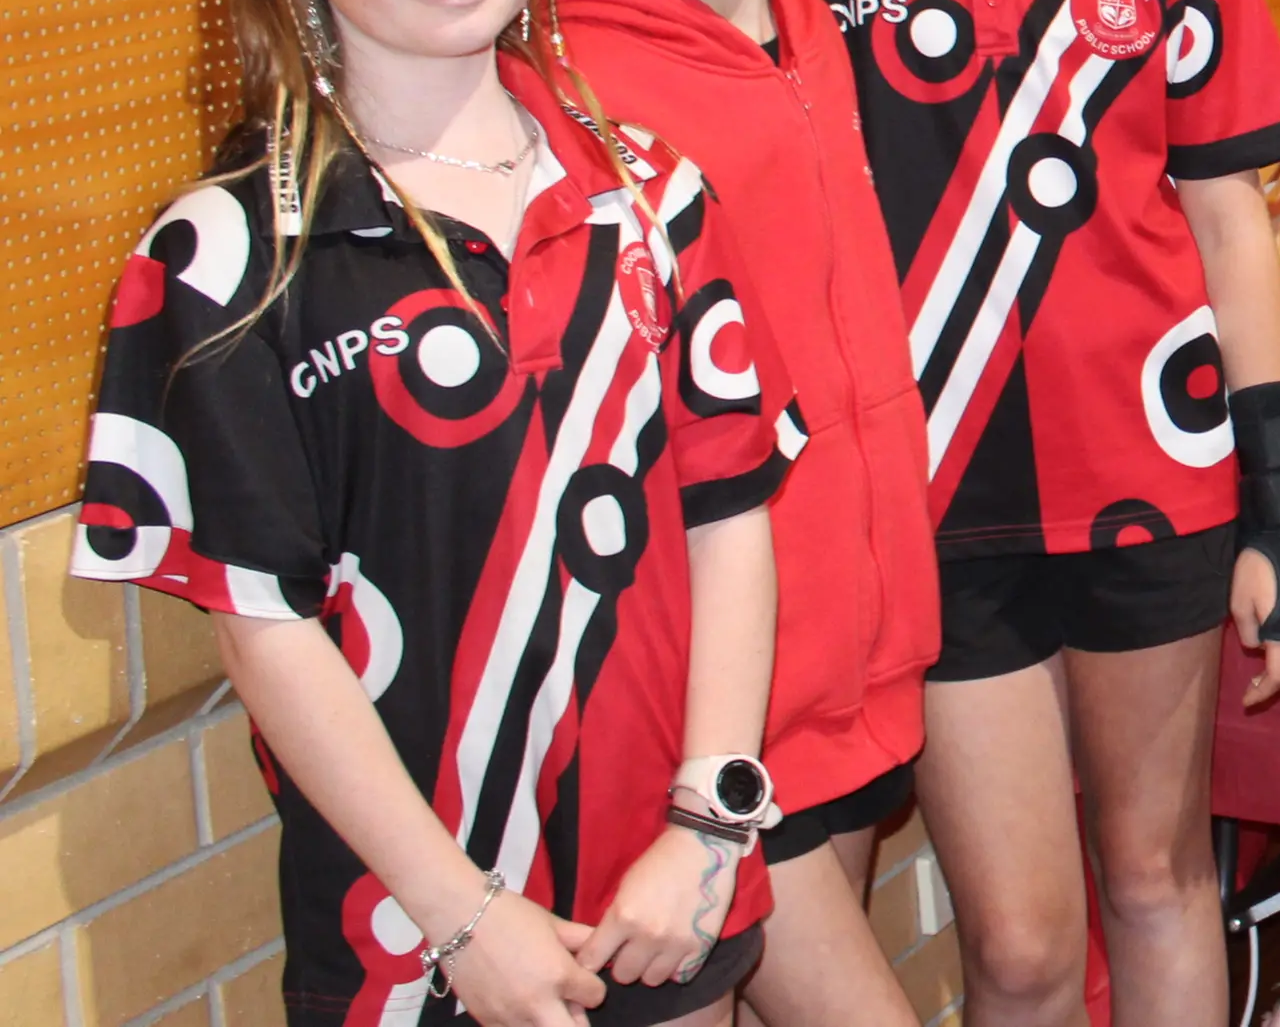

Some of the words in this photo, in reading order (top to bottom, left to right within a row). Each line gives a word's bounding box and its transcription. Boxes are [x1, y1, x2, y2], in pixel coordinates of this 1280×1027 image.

[1075, 18, 1110, 53] PUBLIC
[1110, 30, 1156, 55] SCHOOL
[289, 315, 410, 399] CNPS
